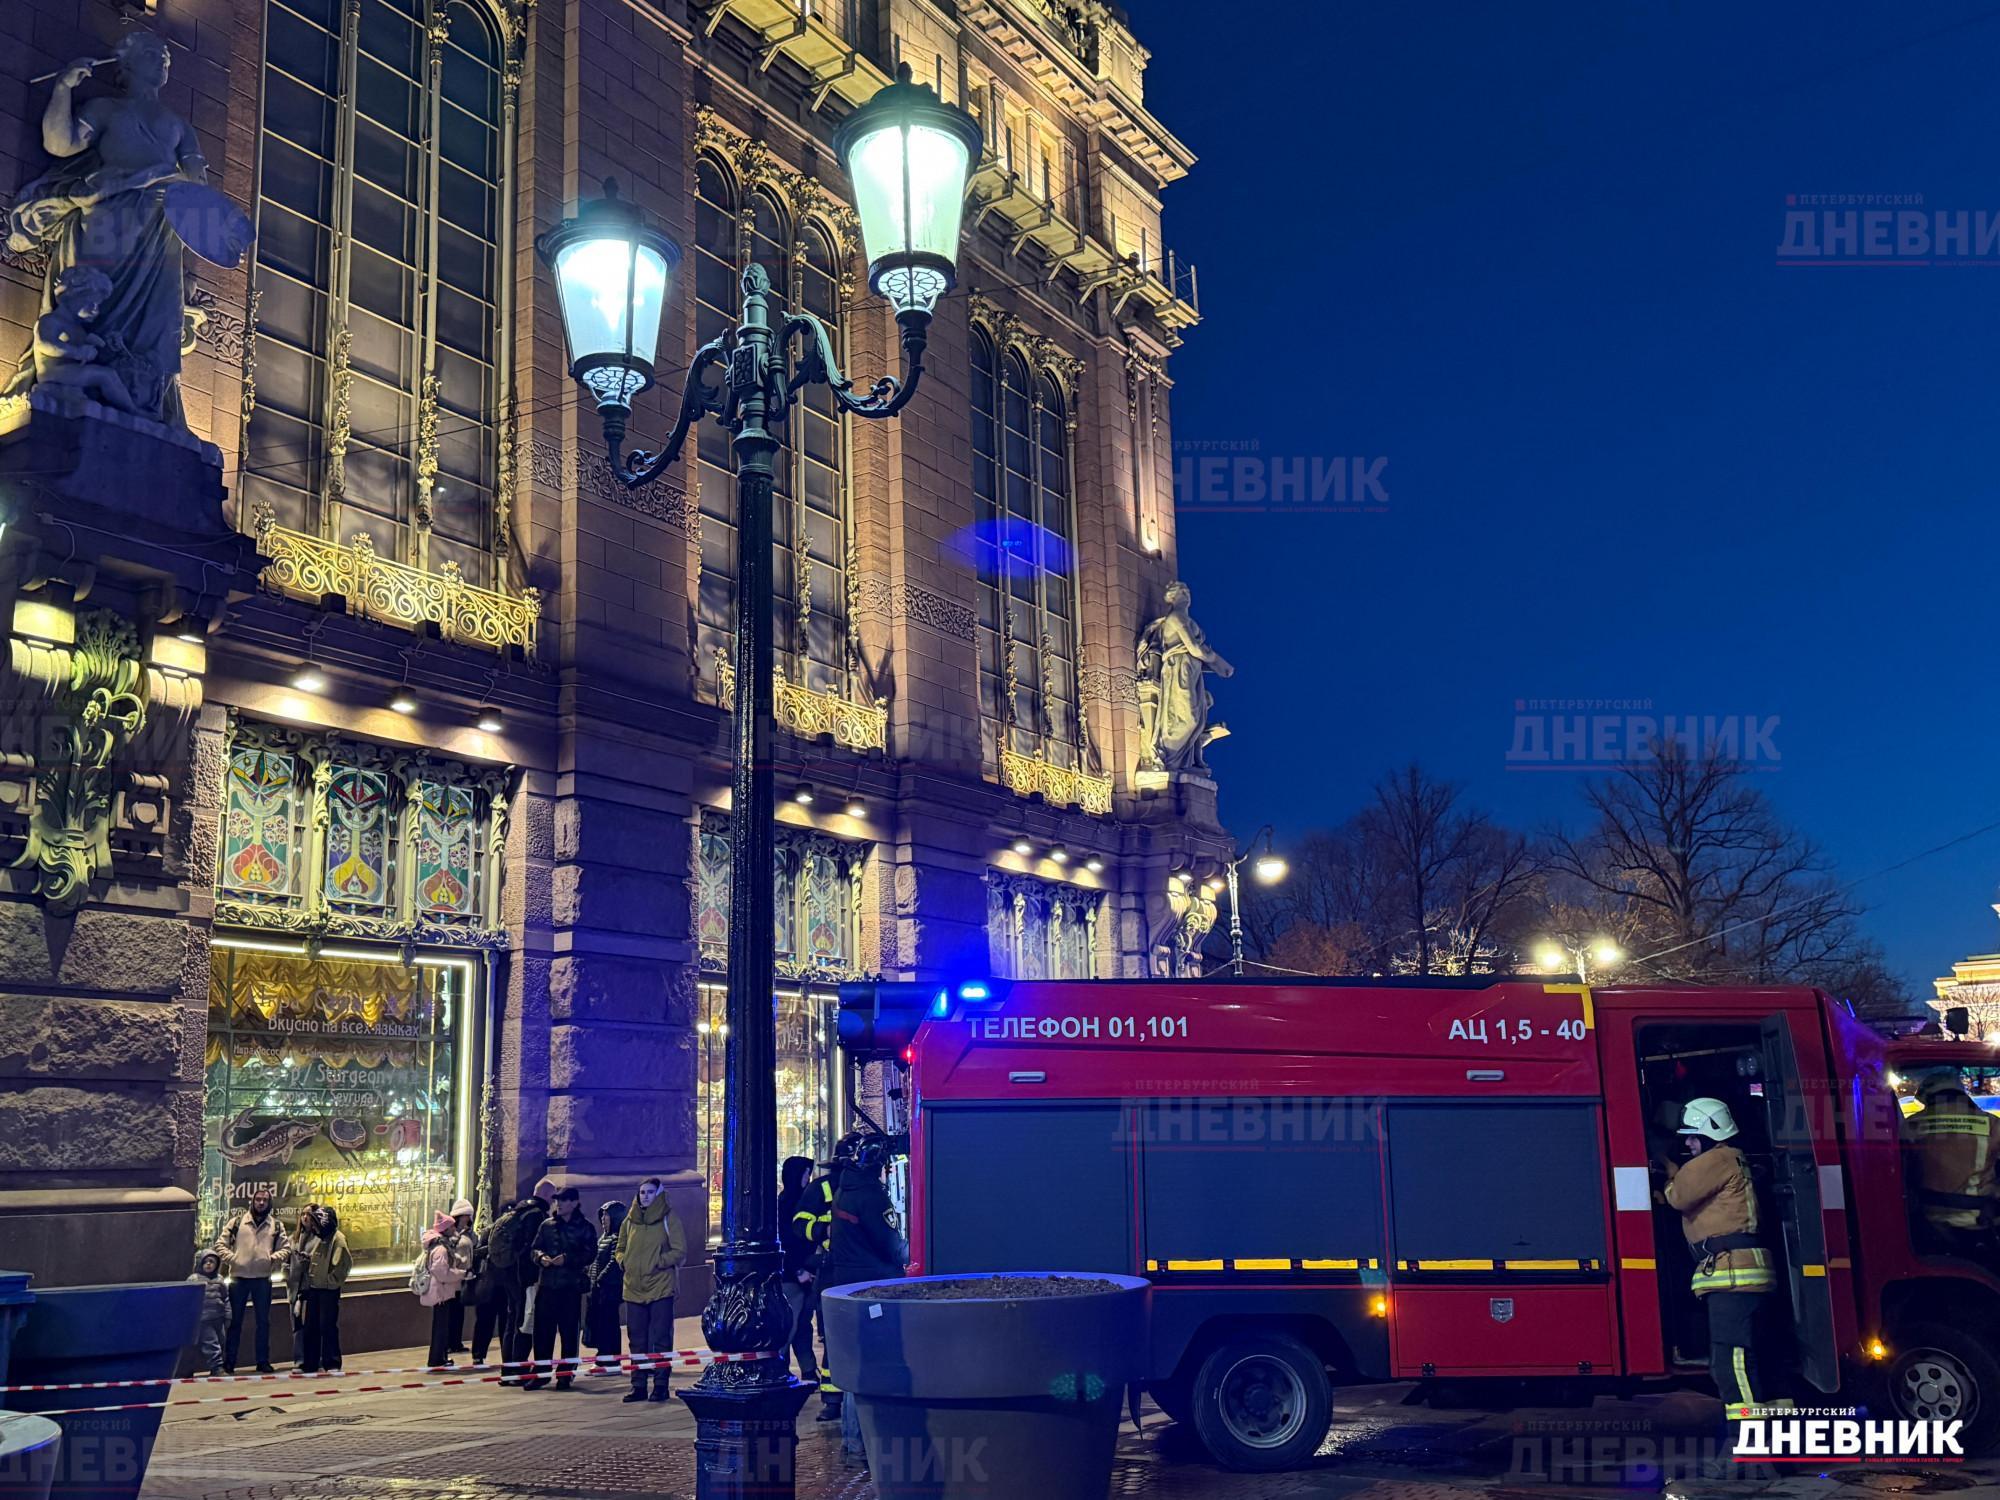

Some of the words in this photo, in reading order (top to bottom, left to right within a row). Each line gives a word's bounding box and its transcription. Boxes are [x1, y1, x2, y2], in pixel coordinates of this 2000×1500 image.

[966, 1016, 1100, 1039] ТЕЛЕФОН
[1108, 1016, 1188, 1042] 01,101
[1449, 1019, 1488, 1044] АЦ
[1495, 1019, 1533, 1045] 1,5
[1556, 1019, 1586, 1041] 40
[316, 1066, 386, 1088] Sturgeon
